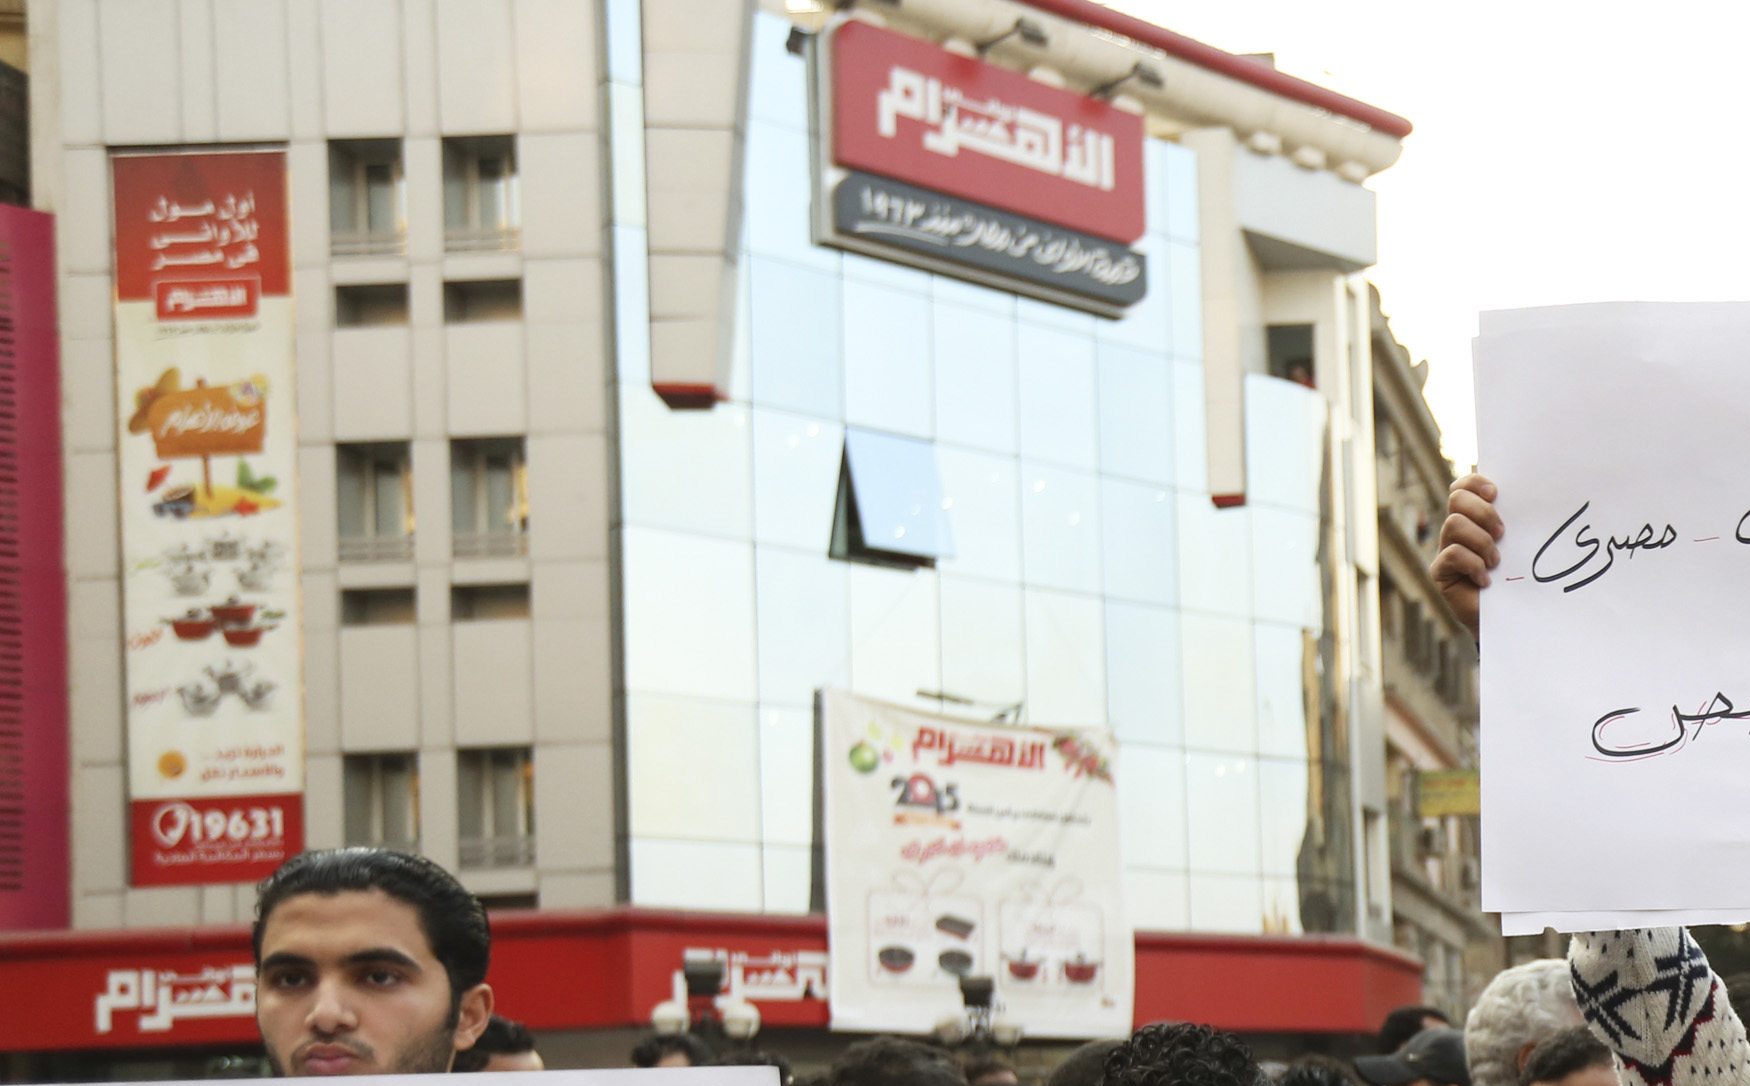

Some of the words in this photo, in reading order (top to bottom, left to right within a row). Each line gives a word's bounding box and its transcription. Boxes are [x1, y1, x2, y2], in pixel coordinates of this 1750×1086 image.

[150, 249, 225, 271] مصر
[190, 806, 284, 842] 19631
[96, 964, 257, 1034] هرام
